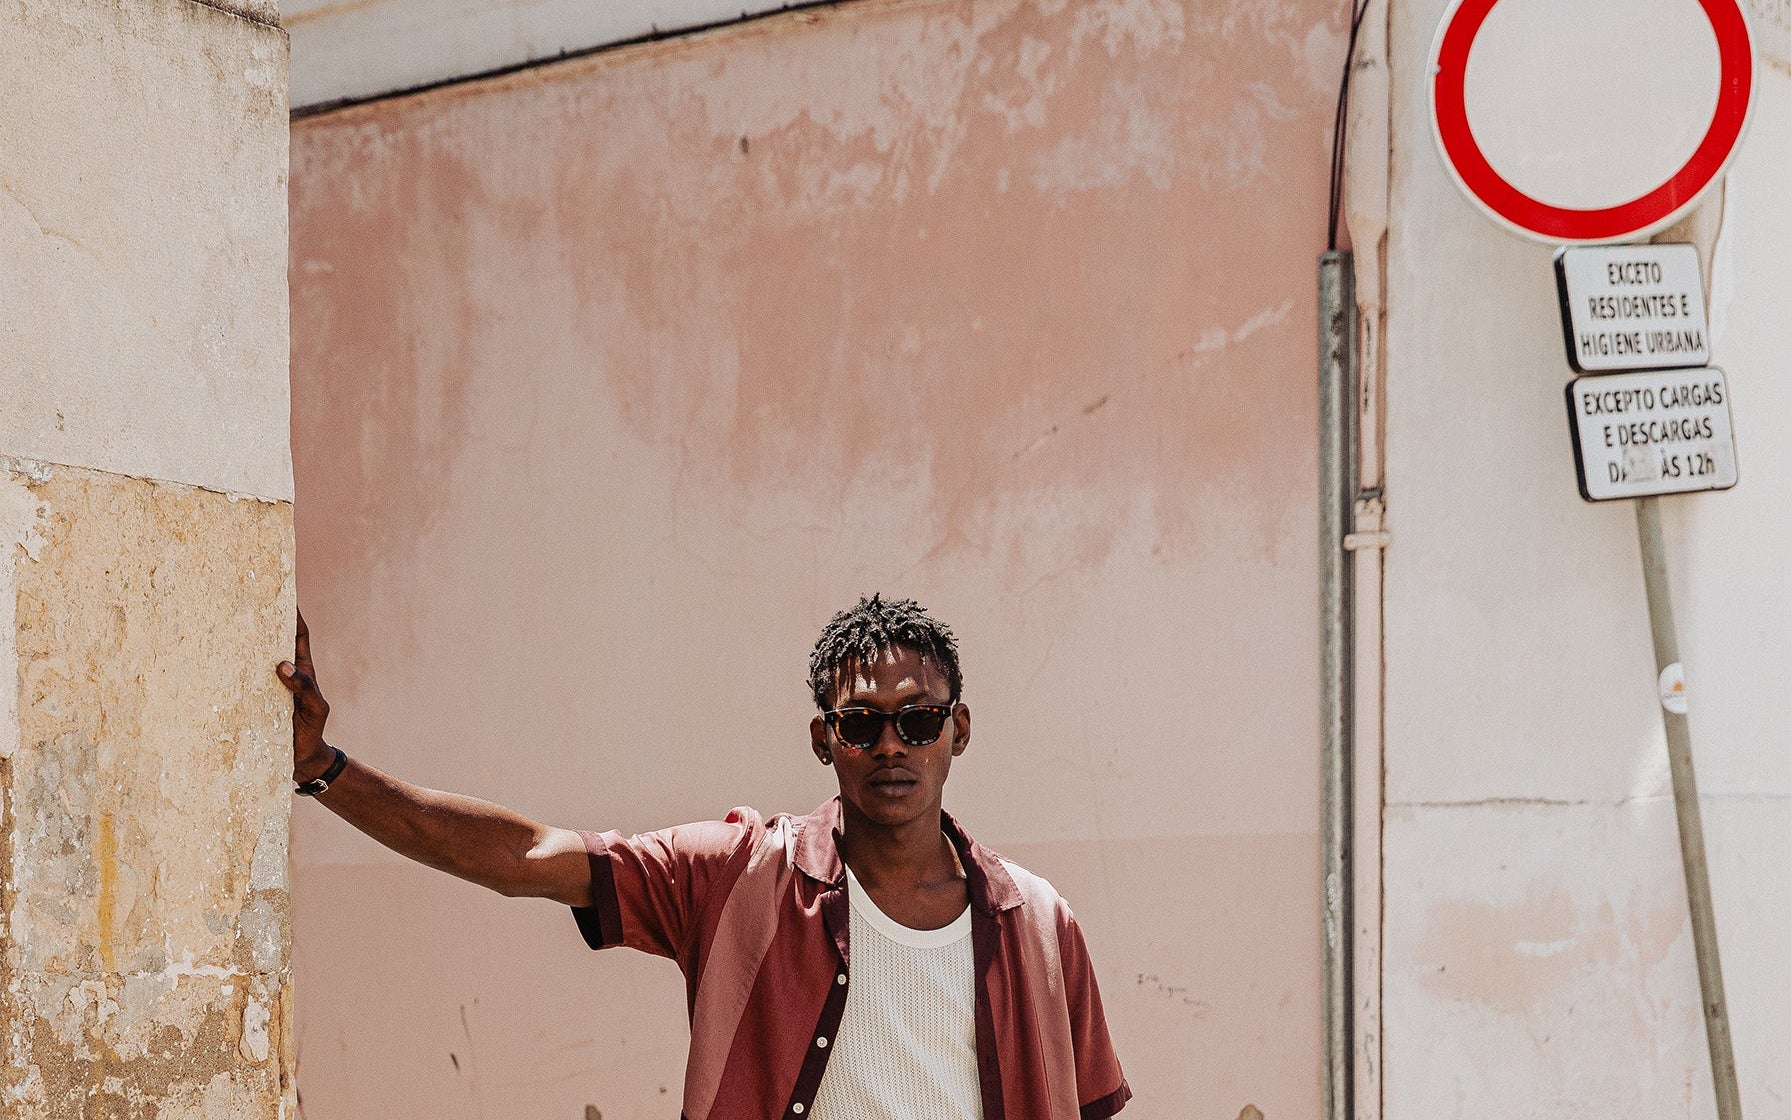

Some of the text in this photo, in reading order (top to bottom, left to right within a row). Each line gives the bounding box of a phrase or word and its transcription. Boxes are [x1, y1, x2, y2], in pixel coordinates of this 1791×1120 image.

[1608, 262, 1661, 285] EXCETO
[1588, 294, 1689, 319] RESIDENTES E
[1580, 330, 1703, 356] HIGIENE URBANA
[1584, 383, 1723, 415] EXCEPTO CARGAS
[1604, 417, 1713, 448] E DESCARGAS
